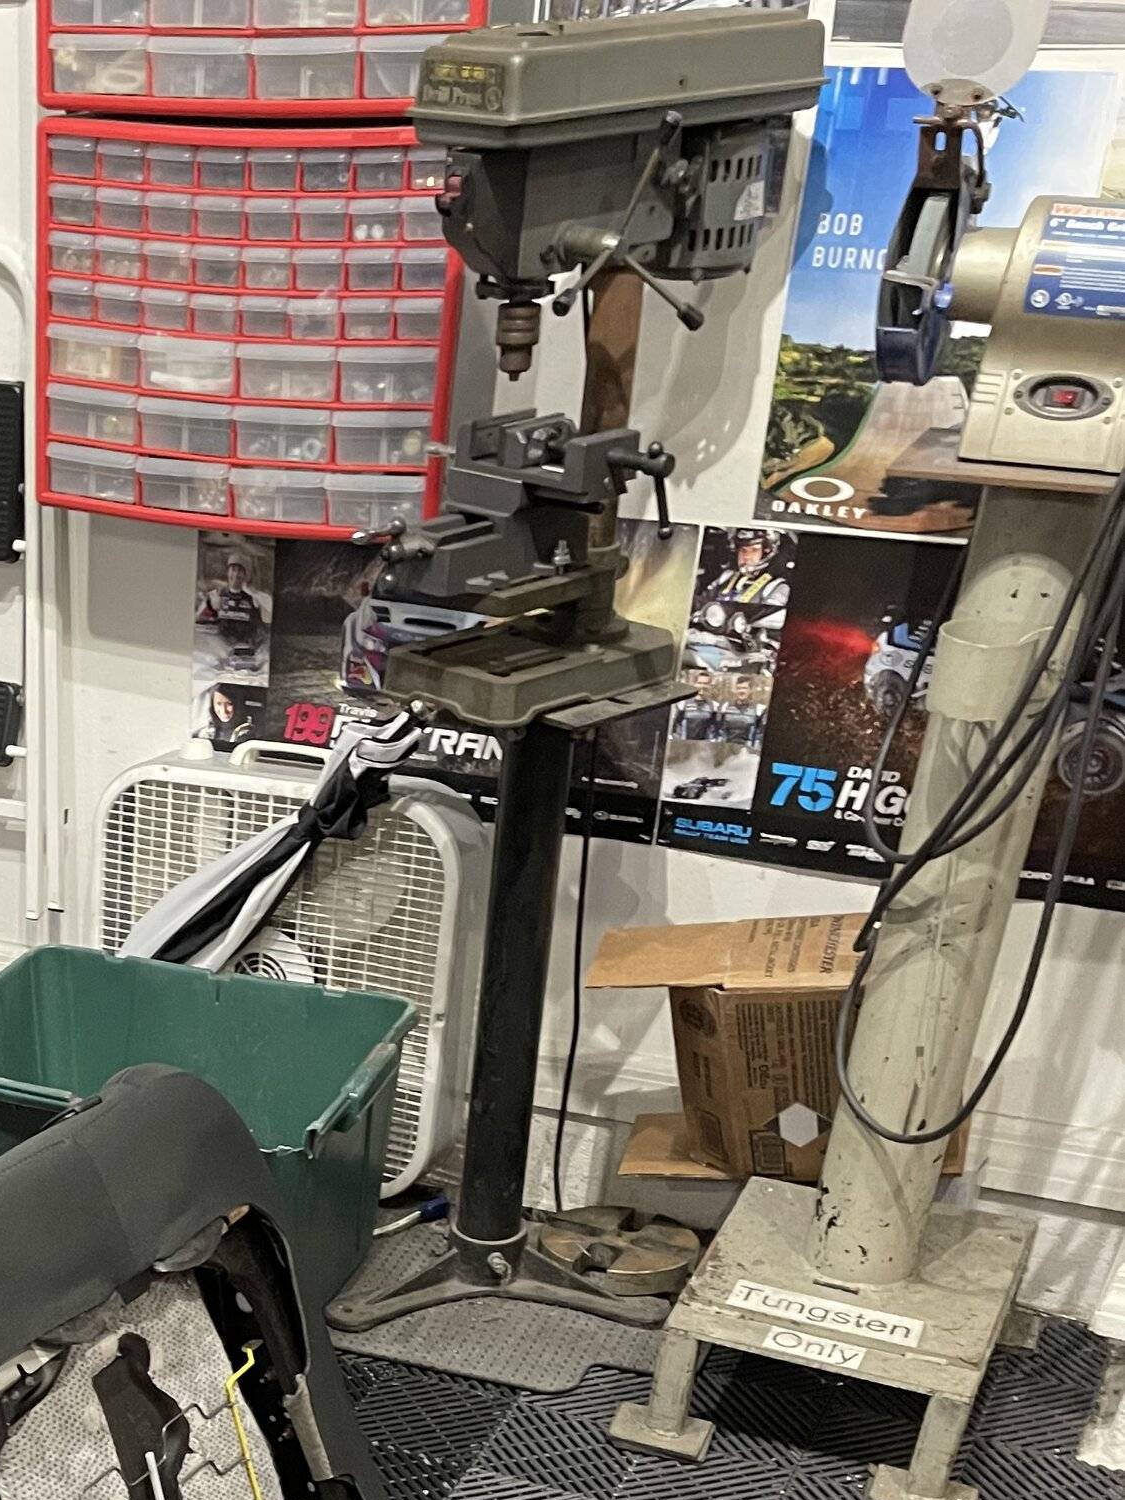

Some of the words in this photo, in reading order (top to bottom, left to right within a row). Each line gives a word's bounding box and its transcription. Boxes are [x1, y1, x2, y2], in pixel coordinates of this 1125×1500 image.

[817, 212, 863, 236] BOB
[771, 500, 867, 519] OAKLEY
[338, 702, 379, 717] Travis
[283, 703, 335, 744] 199
[847, 766, 901, 783] DAID
[770, 762, 837, 812] 75
[676, 817, 752, 838] SUBARU
[739, 1284, 911, 1339] Tungsten
[772, 1331, 860, 1365] Only
